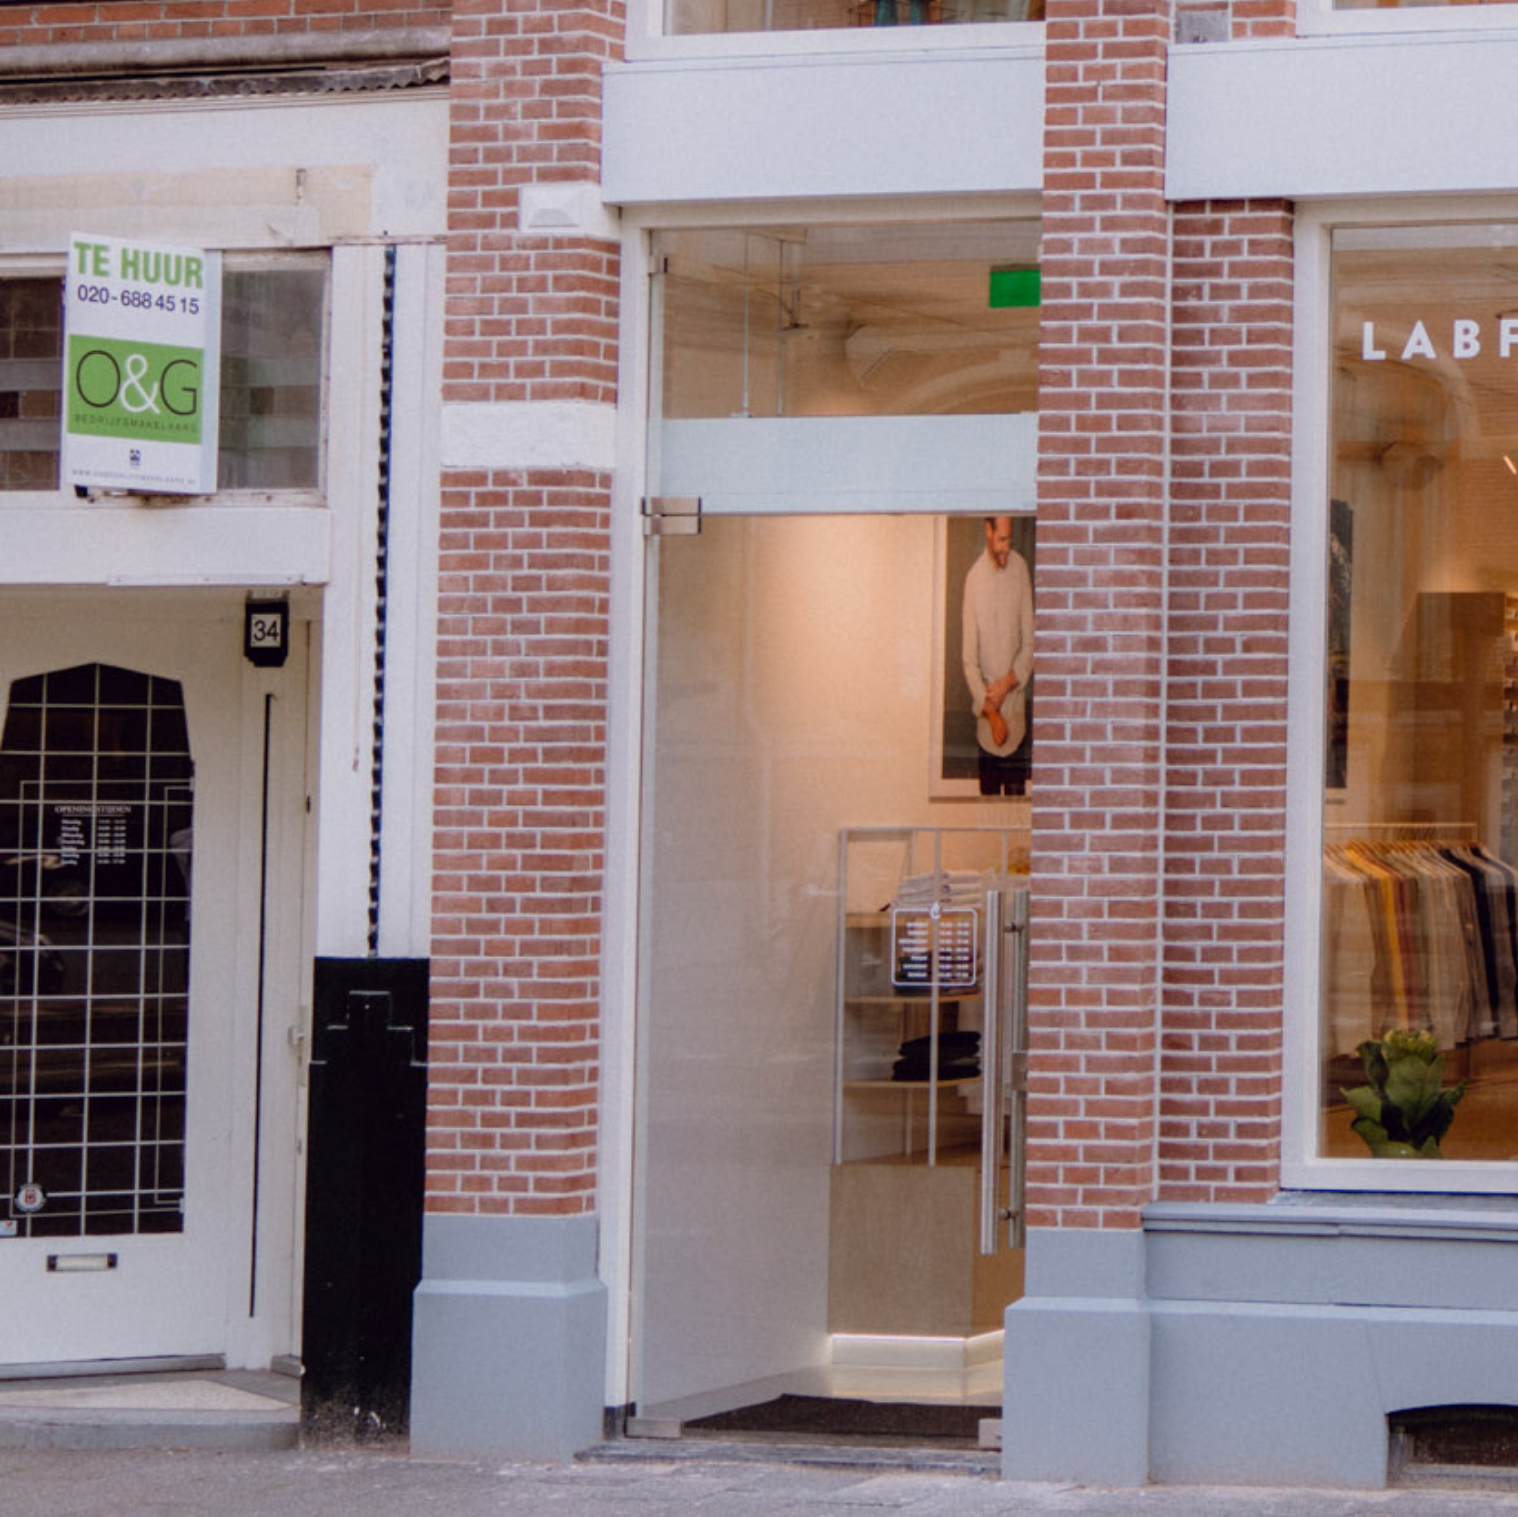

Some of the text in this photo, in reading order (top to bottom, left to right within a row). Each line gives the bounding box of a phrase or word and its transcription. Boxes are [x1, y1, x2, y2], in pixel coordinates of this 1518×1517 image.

[73, 242, 203, 289] TE HUUR
[155, 294, 176, 312] 45
[180, 297, 200, 315] 15
[76, 349, 198, 416] O&G
[254, 619, 280, 642] 34
